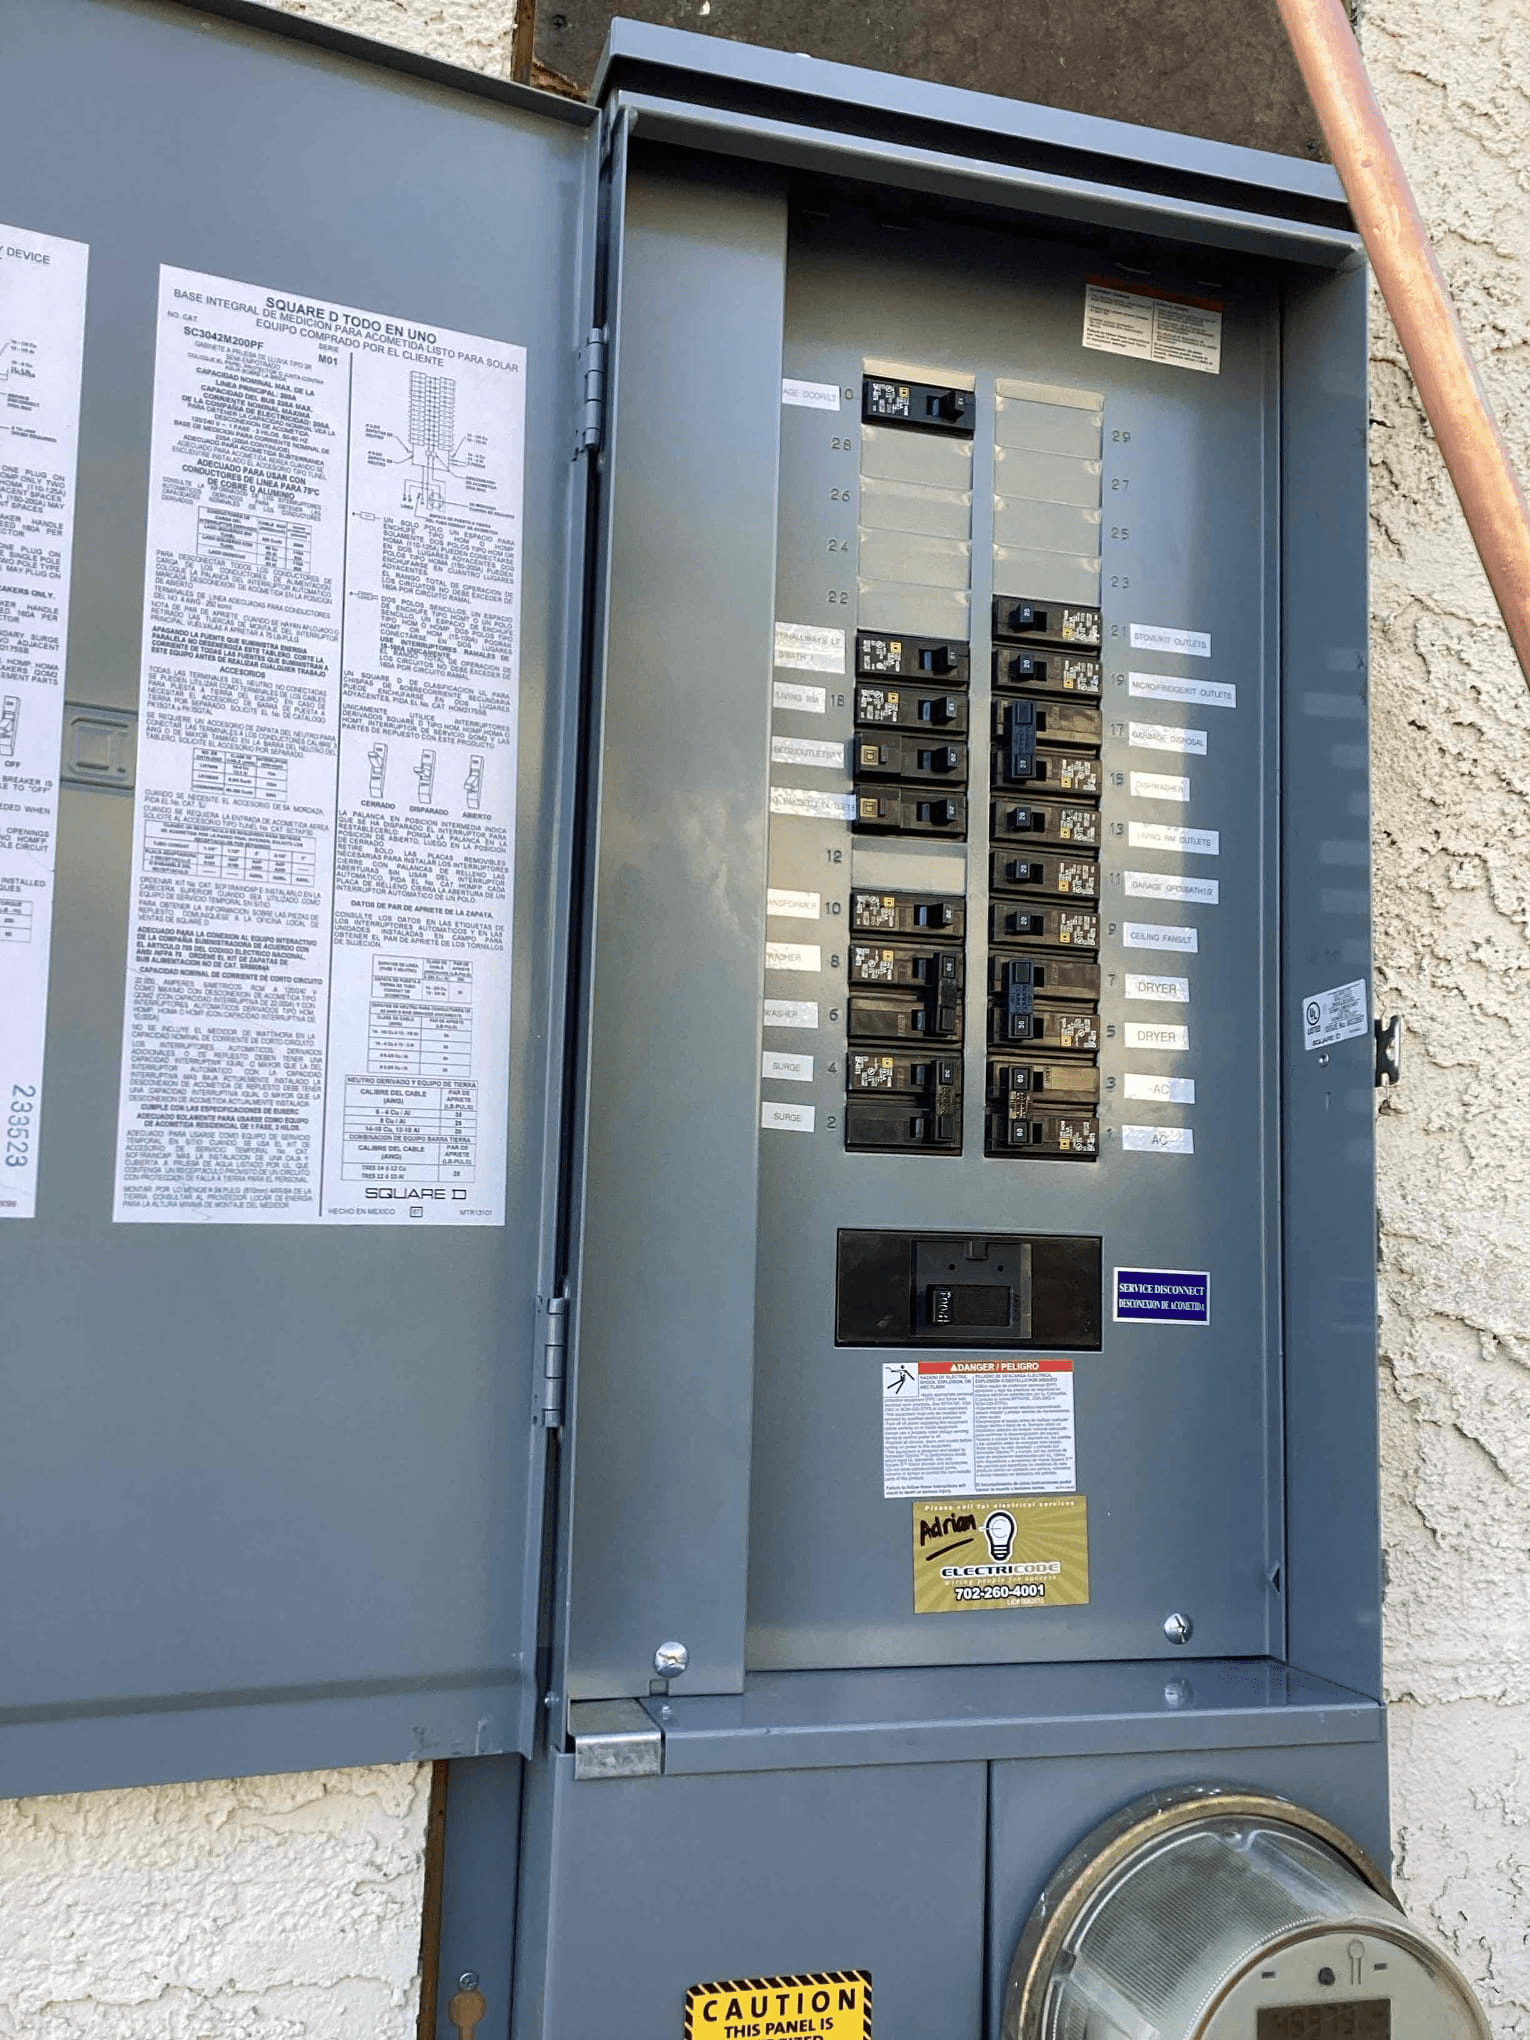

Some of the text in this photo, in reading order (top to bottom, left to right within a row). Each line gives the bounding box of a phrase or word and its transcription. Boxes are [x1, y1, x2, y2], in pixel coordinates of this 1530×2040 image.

[7, 247, 50, 264] DEVICE
[267, 297, 436, 344] SQUARE D TODO EN UNO
[174, 288, 519, 372] BASE INTEGRAL DE MEDICION PARA ACOMETIDA LISTO PARA SOLAR
[184, 326, 264, 350] SC3042M200PF
[256, 318, 444, 367] EQUIPO COMPRADO POR EL CLIENTE
[318, 354, 338, 365] M01
[1112, 430, 1131, 443] 29
[832, 437, 851, 451] 28
[197, 458, 306, 485] ADECUADO PARA USAR CON
[182, 464, 242, 482] CONDUCTORES
[244, 475, 254, 484] DE
[256, 477, 279, 489] LINEA
[281, 482, 301, 493] PARA
[1112, 478, 1130, 491] 27
[208, 477, 220, 487] DE
[222, 480, 248, 492] COBRE
[258, 486, 295, 500] ALUMINIO
[830, 488, 850, 501] 26
[1111, 527, 1129, 540] 25
[829, 539, 848, 552] 24
[1111, 576, 1129, 588] 23
[828, 591, 848, 604] 22
[1111, 624, 1126, 638] 21
[18, 639, 59, 651] ADJACENT
[31, 634, 59, 643] SURGE
[1175, 637, 1206, 649] OUTLETS
[1112, 673, 1125, 686] 19
[1200, 688, 1231, 699] OUTLETS
[831, 694, 845, 707] 18
[1111, 723, 1124, 736] 17
[1170, 734, 1204, 746] DISPOSAL
[5, 760, 21, 768] OFF
[2, 775, 41, 785] BREAKER
[1111, 772, 1124, 785] 15
[361, 800, 396, 809] CERRADO
[409, 806, 449, 815] DISPARADO
[462, 812, 492, 820] ABIERTO
[7, 828, 49, 837] OPENINGS
[1111, 823, 1124, 835] 13
[1180, 836, 1211, 846] OUTLETS
[827, 850, 842, 863] 12
[1, 878, 46, 887] INSTALLED
[1110, 873, 1121, 886] 11
[351, 900, 374, 908] DATOS
[415, 905, 442, 914] APRIETE
[826, 902, 841, 915] 10
[1108, 923, 1116, 935] 9
[1130, 932, 1160, 942] CEILING
[831, 955, 839, 968] 8
[1108, 974, 1115, 986] 7
[1138, 982, 1177, 993] DRYER
[830, 1008, 838, 1021] 6
[1107, 1025, 1115, 1038] 5
[1138, 1031, 1176, 1043] DRYER
[773, 1062, 800, 1072] SURGE
[828, 1062, 837, 1073] 4
[1106, 1077, 1116, 1089] 3
[774, 1112, 802, 1122] SURGE
[827, 1116, 836, 1128] 2
[5, 1084, 36, 1167] 233523
[1152, 1134, 1168, 1145] AC
[366, 1188, 466, 1199] SQUARE D
[1119, 1283, 1204, 1295] SERVICE DISCONNECT
[1161, 1301, 1169, 1309] DE
[1171, 1301, 1205, 1311] ACOMETIDA
[958, 1363, 994, 1372] DANGER
[1002, 1362, 1039, 1370] PELIGRO
[920, 1513, 977, 1546] Adrian
[942, 1563, 1060, 1577] ELECTRICODE
[955, 1583, 1045, 1601] 702-260-4001
[703, 1988, 856, 2022] CAUTION
[724, 2025, 760, 2039] THIS
[766, 2020, 815, 2036] PANEL
[821, 2017, 834, 2030] IS
